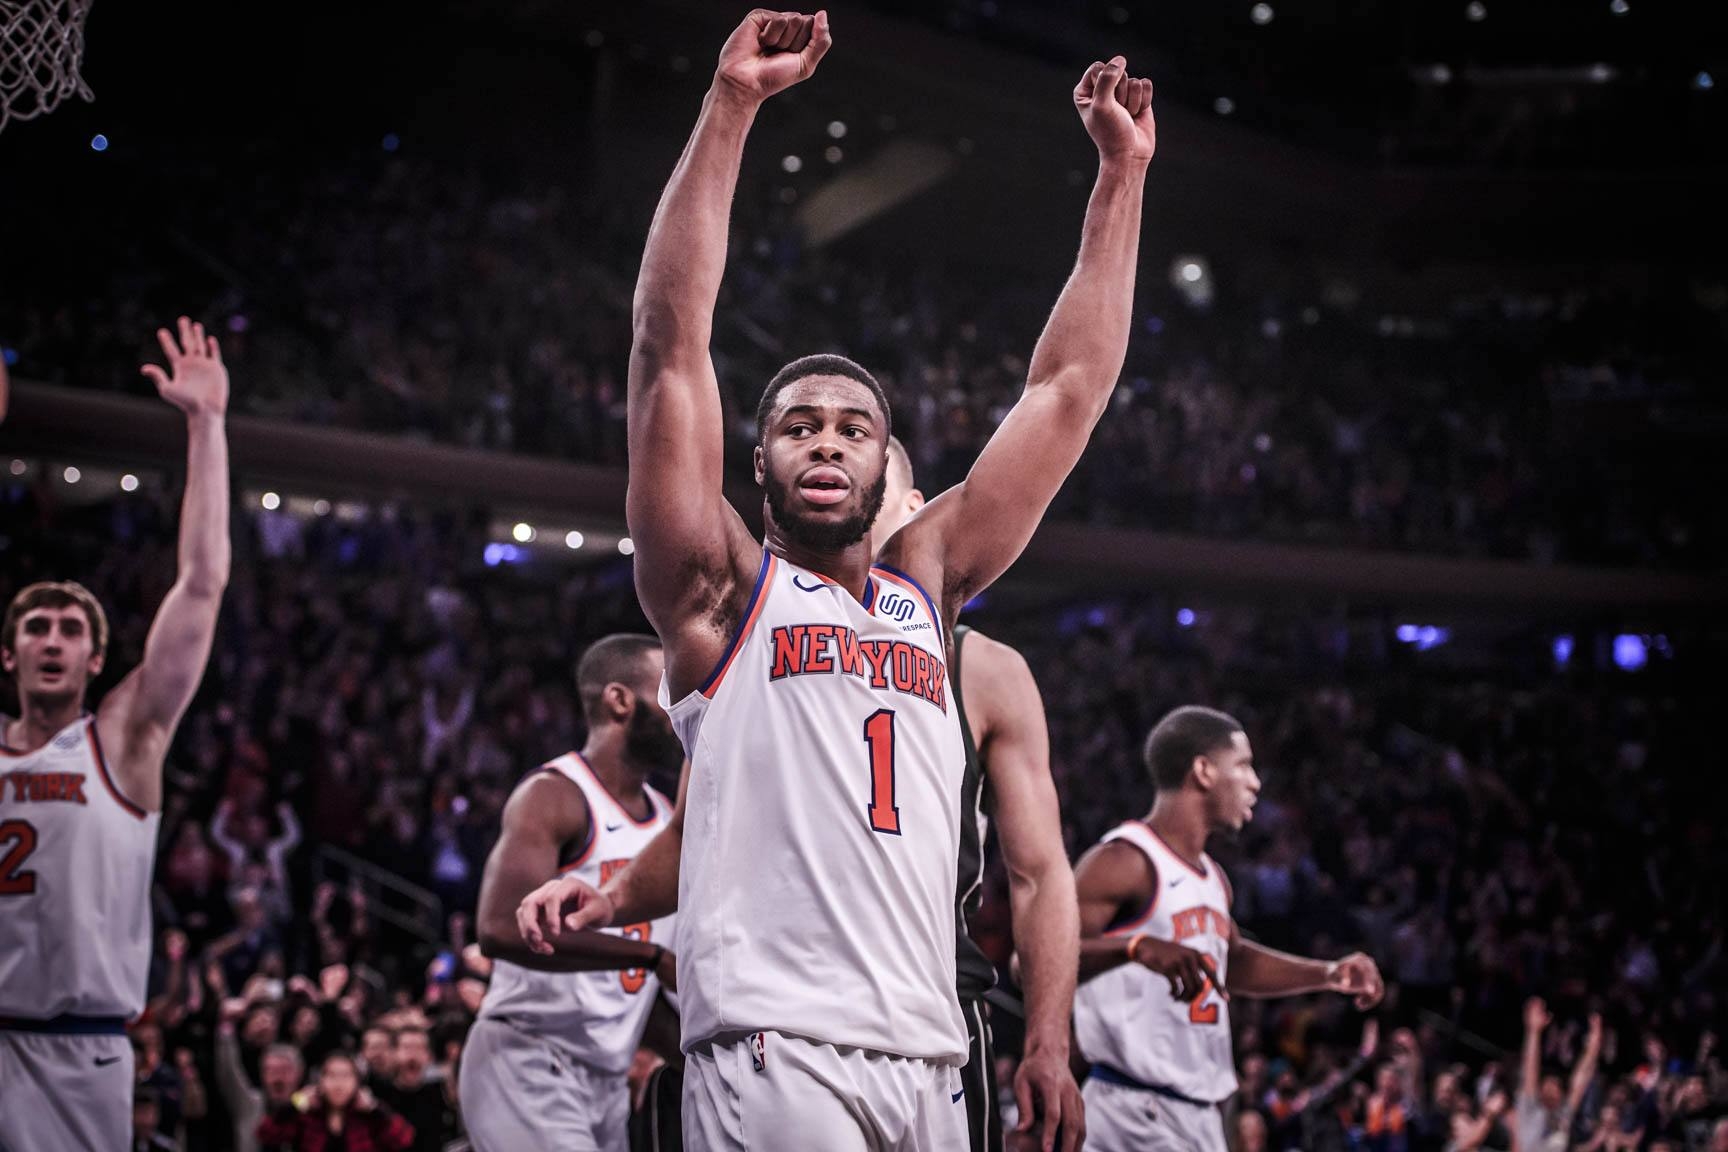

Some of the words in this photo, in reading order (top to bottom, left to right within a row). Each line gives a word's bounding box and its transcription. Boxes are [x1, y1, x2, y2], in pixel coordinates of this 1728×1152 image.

[901, 622, 931, 632] RESPACE
[769, 624, 865, 682] NEW
[856, 640, 947, 716] YORK
[10, 771, 88, 805] YORK
[863, 708, 902, 836] 1
[0, 818, 38, 895] 2
